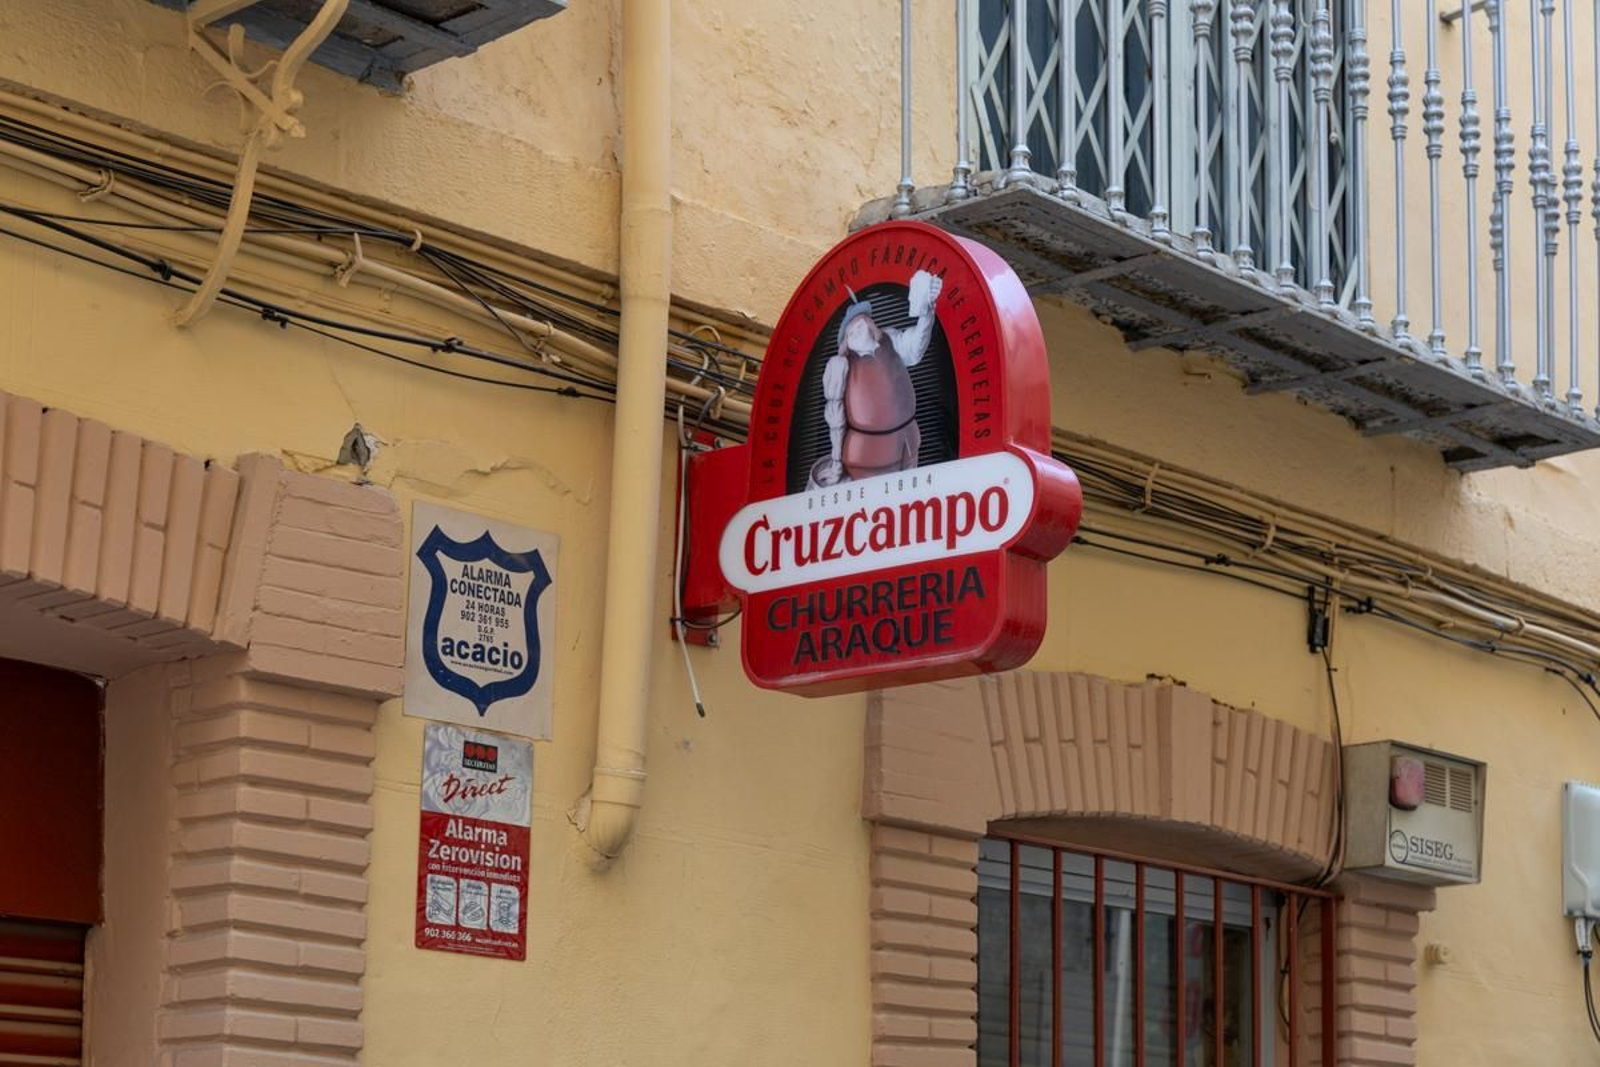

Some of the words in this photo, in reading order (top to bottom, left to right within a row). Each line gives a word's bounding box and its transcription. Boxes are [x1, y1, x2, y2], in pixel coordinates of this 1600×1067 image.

[803, 257, 859, 322] CAMPO
[947, 286, 965, 310] DE
[960, 315, 992, 439] CERVEZAS
[808, 487, 865, 510] DESDE
[744, 485, 1009, 576] Cruzcampo
[461, 564, 511, 589] ALARMA
[449, 578, 522, 608] CONECTADA
[767, 565, 986, 632] CHURRERIA
[460, 610, 475, 622] 902
[465, 599, 476, 610] 24
[478, 602, 506, 617] HORAS
[793, 608, 956, 666] ARAQUE
[441, 636, 523, 670] acacio
[442, 773, 517, 803] Direct
[445, 819, 508, 846] Alarma
[428, 838, 522, 871] Zerovision
[1409, 835, 1454, 861] SISEG
[427, 863, 441, 871] con
[424, 927, 440, 938] 902
